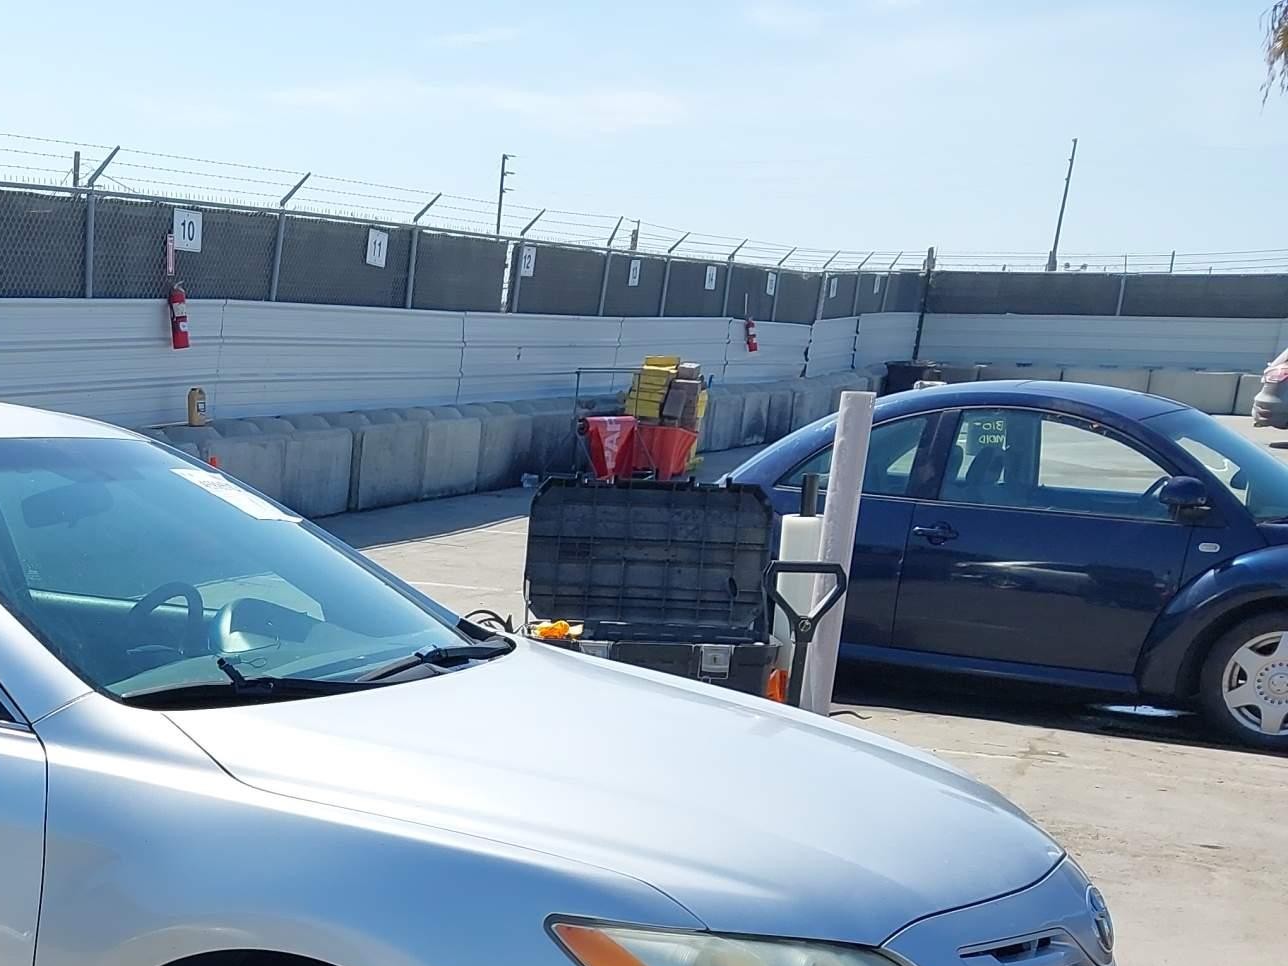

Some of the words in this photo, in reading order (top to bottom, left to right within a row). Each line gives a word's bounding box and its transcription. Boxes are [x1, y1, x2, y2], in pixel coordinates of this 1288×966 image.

[181, 219, 195, 241] 10
[372, 239, 382, 258] 11
[523, 254, 532, 270] 12
